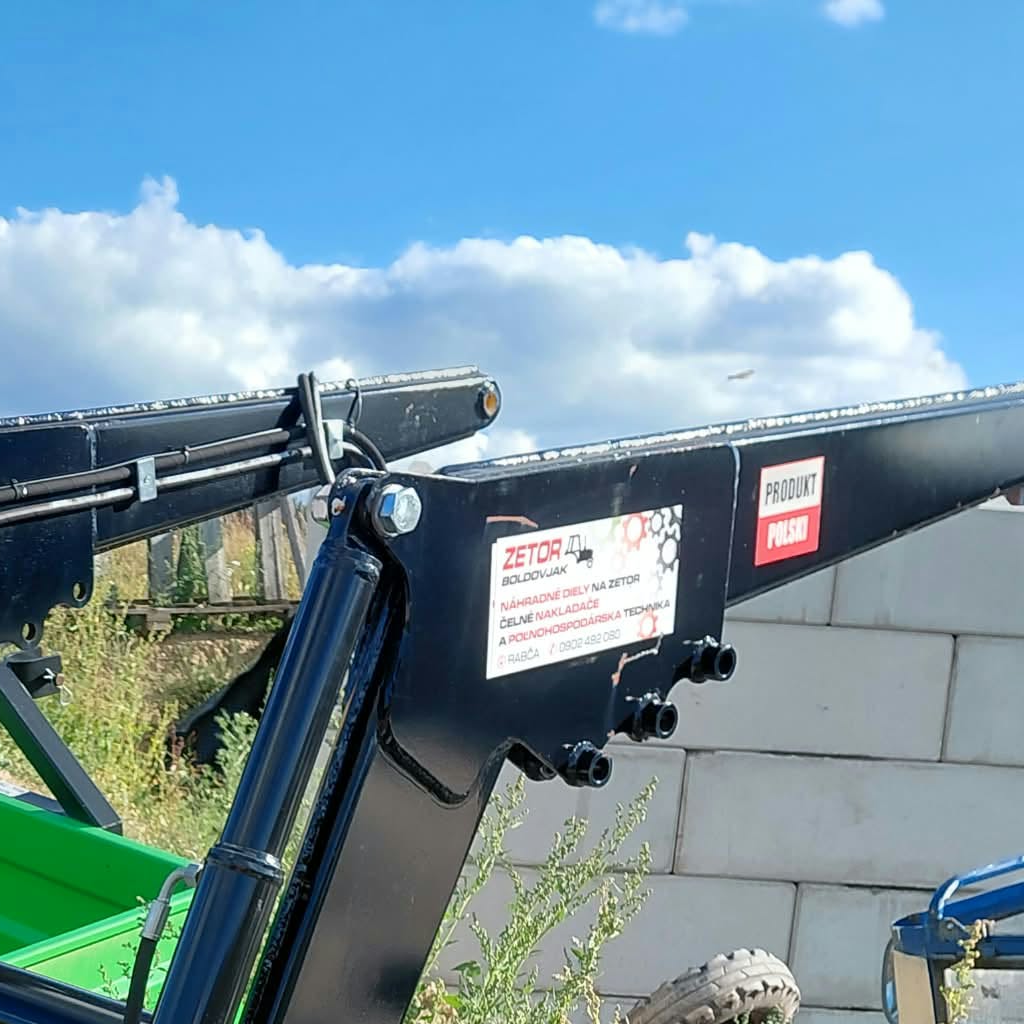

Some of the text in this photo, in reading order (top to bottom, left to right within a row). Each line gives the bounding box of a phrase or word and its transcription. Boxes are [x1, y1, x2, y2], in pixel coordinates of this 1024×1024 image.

[765, 472, 817, 506] PRODUKT
[767, 514, 809, 550] POLSKI
[502, 538, 563, 570] ZETOR
[501, 564, 568, 586] BOLDOVJAK
[500, 573, 640, 612] NÁHRADNÉ DIELY NA ZETOR
[498, 636, 507, 647] A
[623, 599, 671, 617] TECHNIKA
[499, 598, 600, 629] ČELNÉ NAKLADAČE
